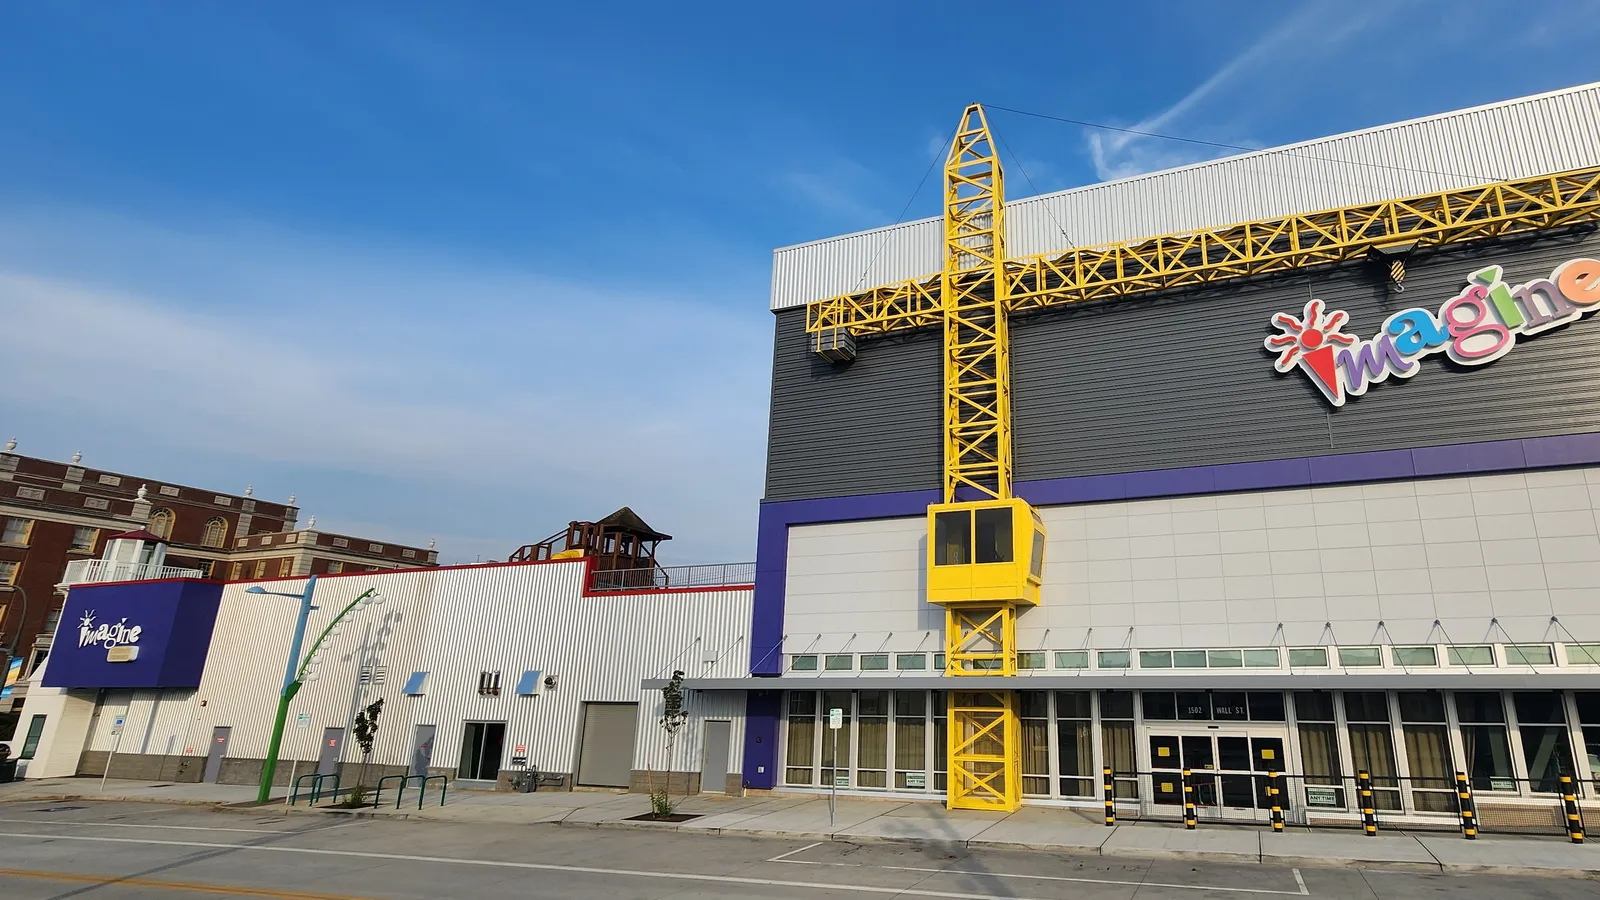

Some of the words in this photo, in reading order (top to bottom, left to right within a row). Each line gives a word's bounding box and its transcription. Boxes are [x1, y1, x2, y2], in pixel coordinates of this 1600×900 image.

[1264, 256, 1600, 406] imagine
[77, 609, 142, 649] imagine
[1188, 706, 1202, 714] 1502
[1216, 706, 1232, 715] WALL
